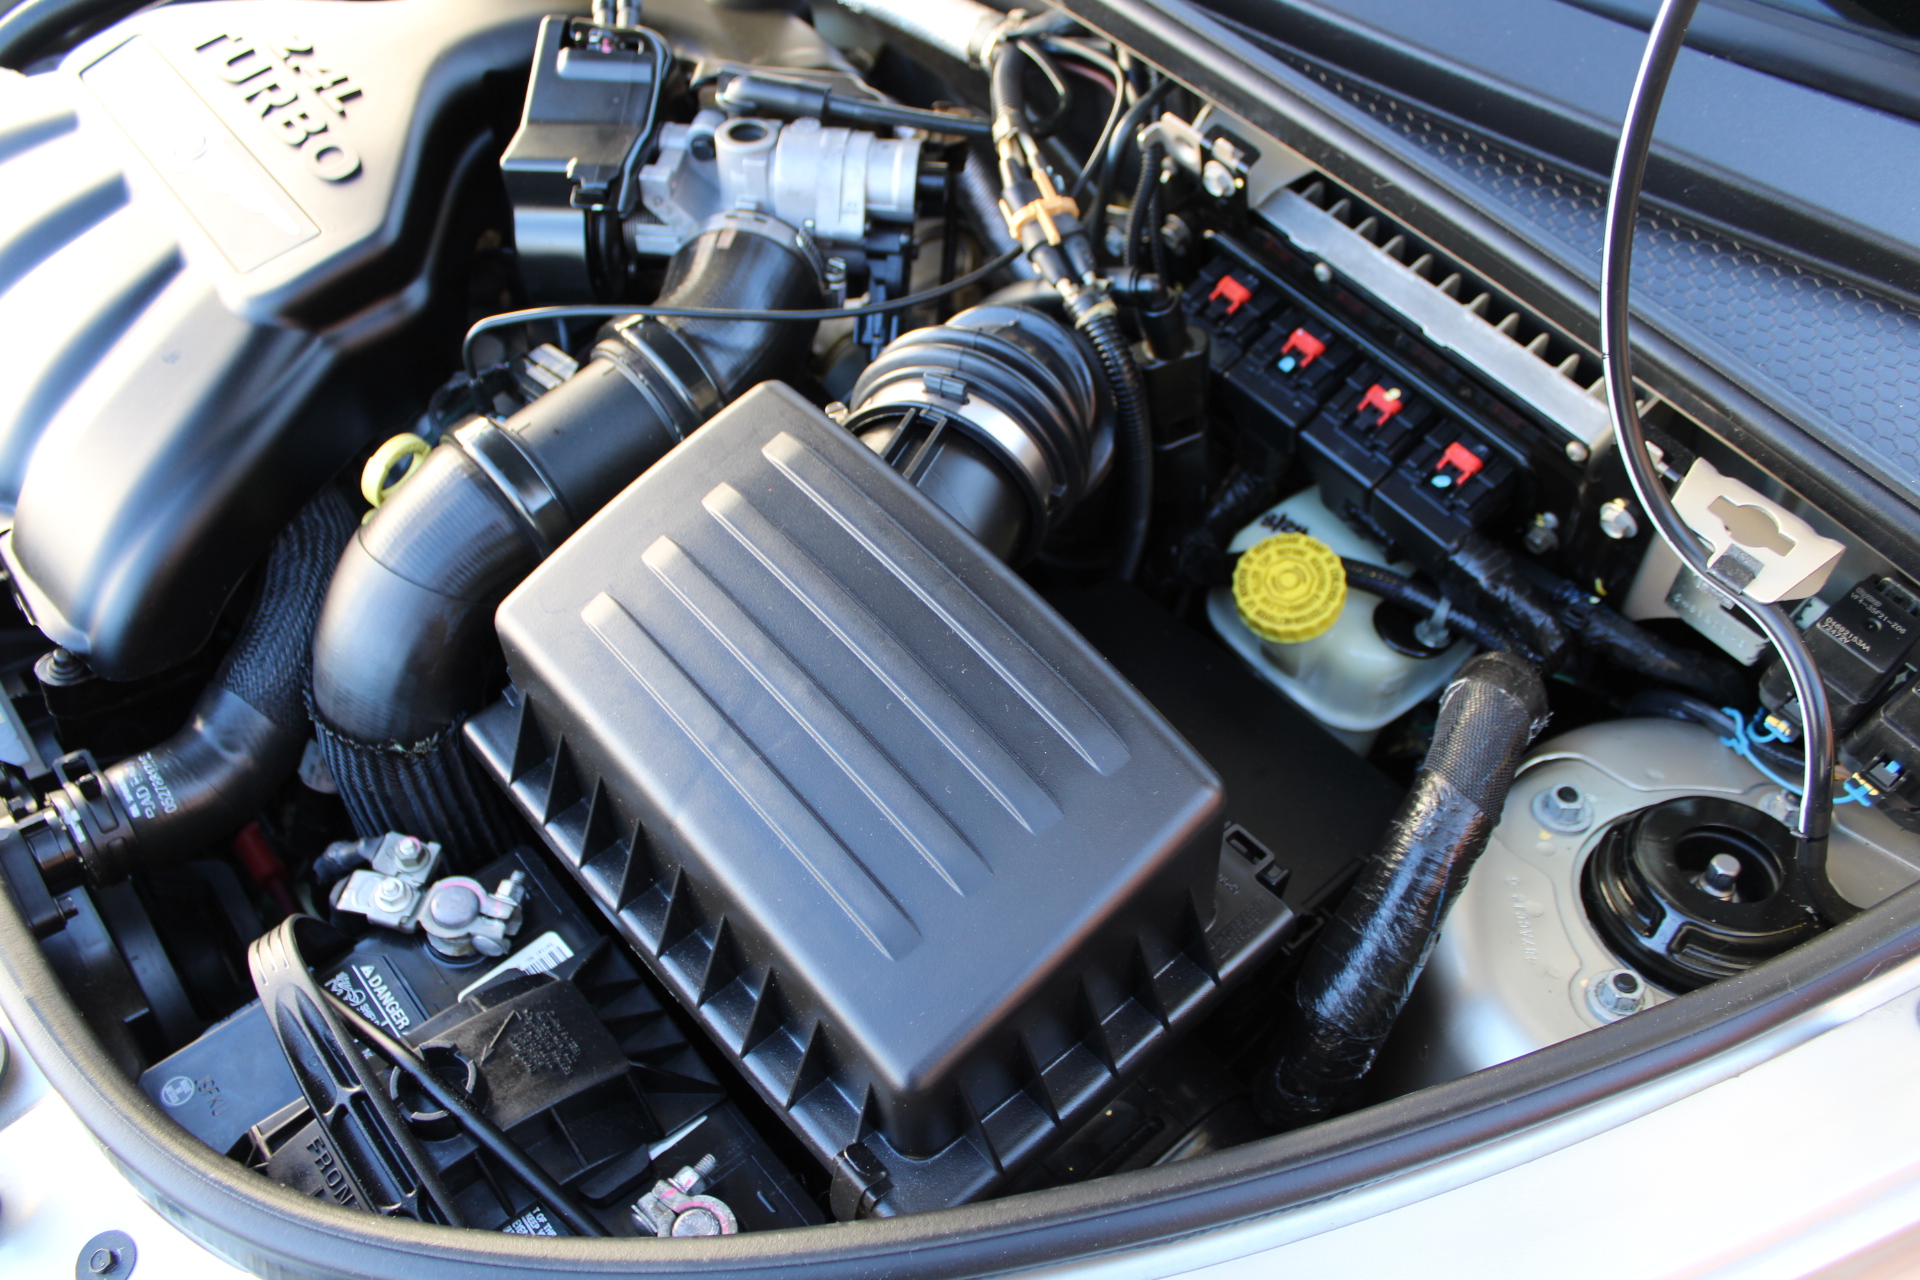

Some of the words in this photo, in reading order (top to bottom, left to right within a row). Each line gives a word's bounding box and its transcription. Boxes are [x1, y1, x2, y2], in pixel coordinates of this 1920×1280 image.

[193, 32, 364, 185] TURBO
[368, 974, 410, 1030] DANGER
[306, 1136, 364, 1210] FRON
